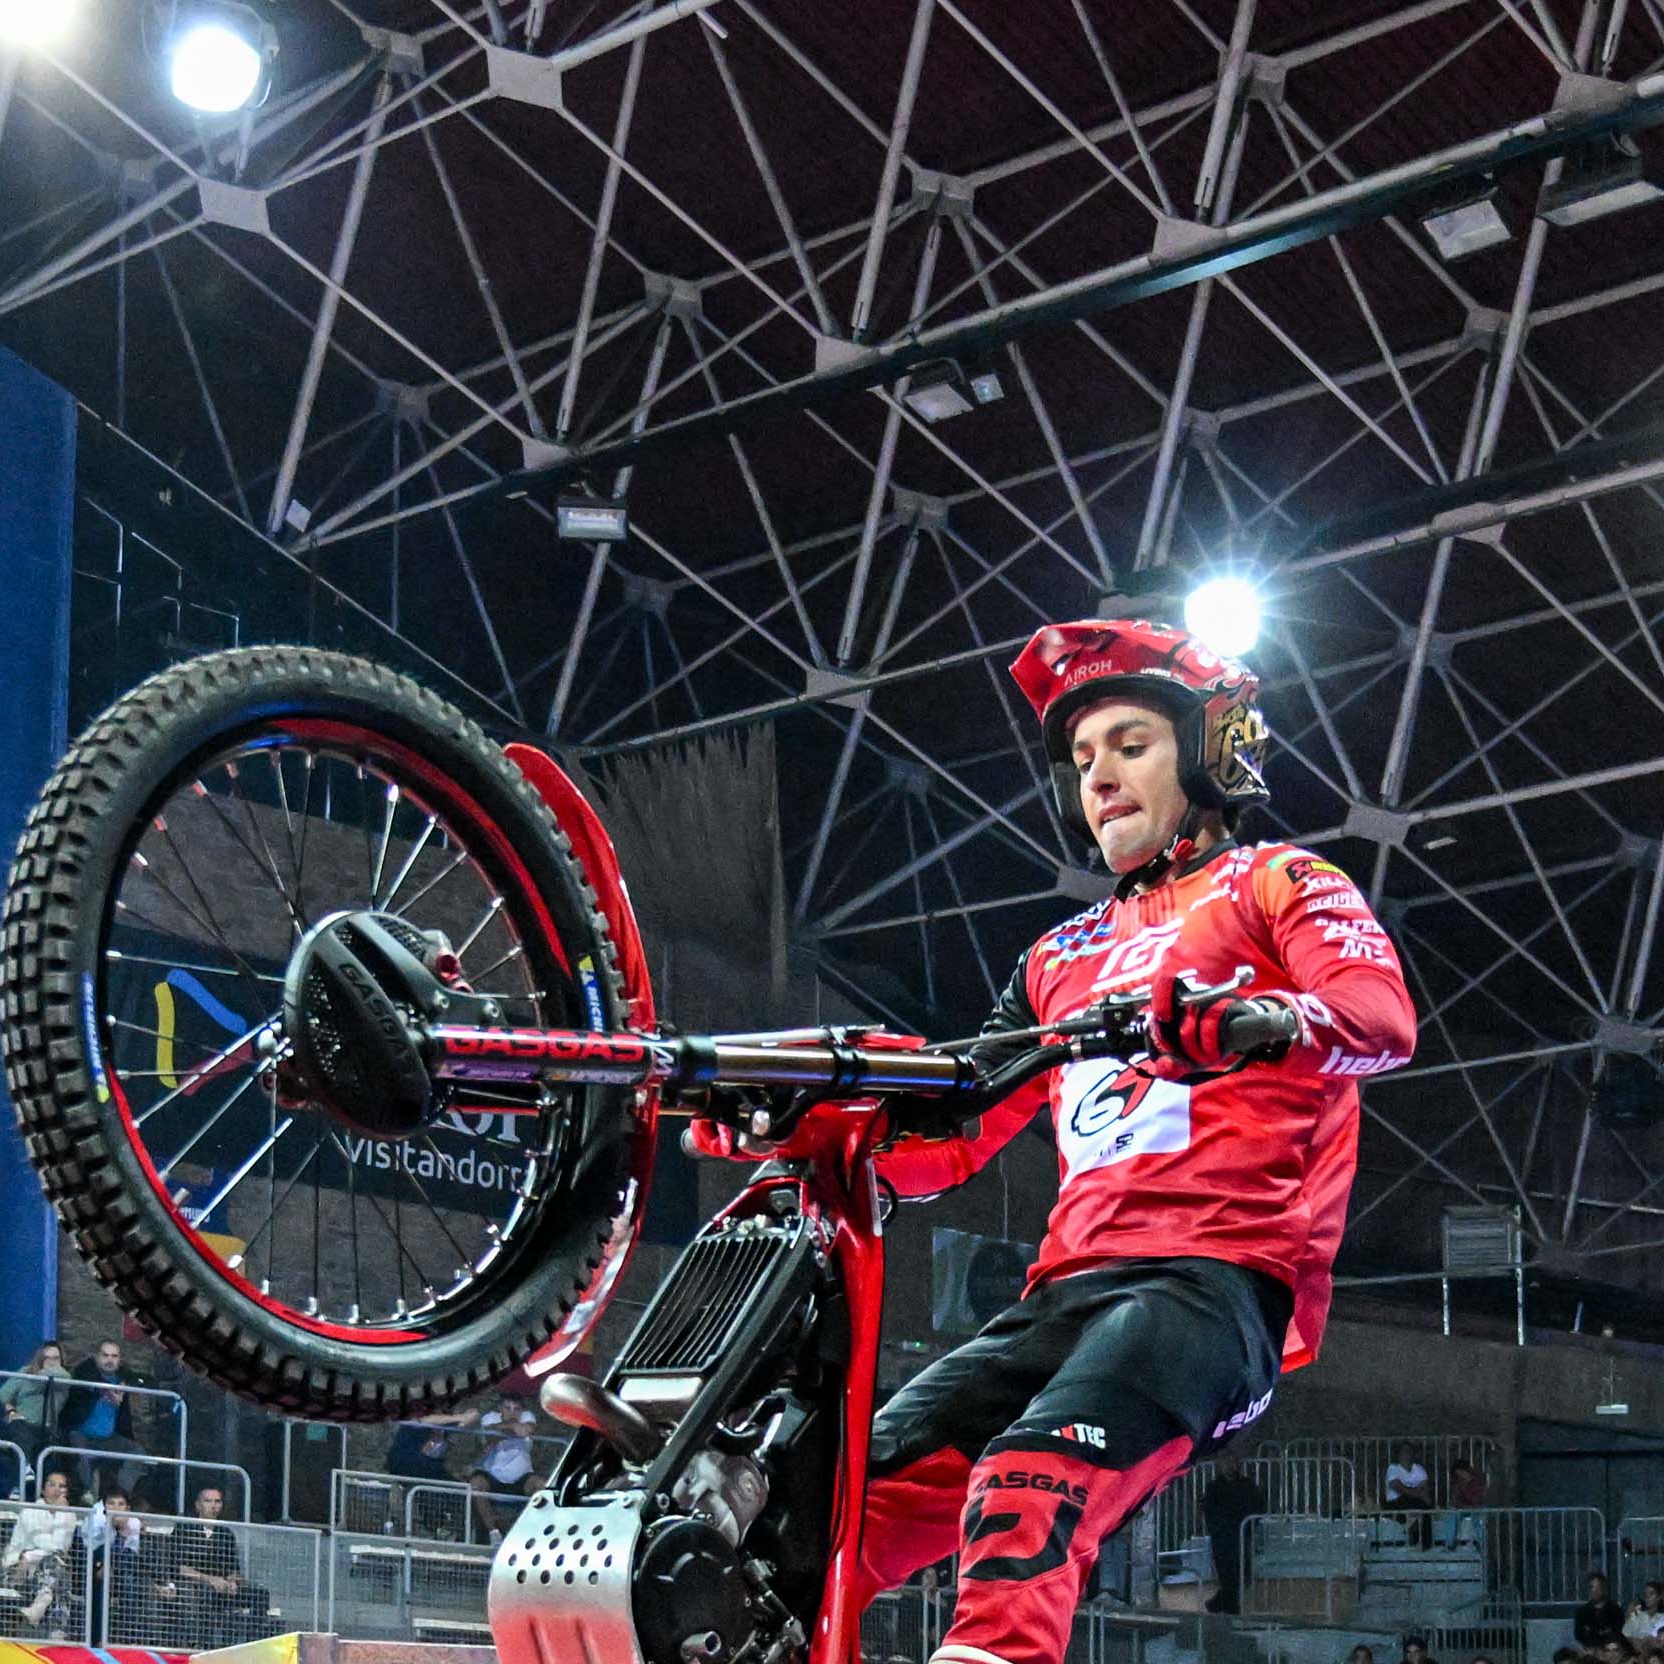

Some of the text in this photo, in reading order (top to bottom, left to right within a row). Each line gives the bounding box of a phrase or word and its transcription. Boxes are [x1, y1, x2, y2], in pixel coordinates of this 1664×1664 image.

[1064, 659, 1112, 687] AIROH
[444, 1026, 645, 1062] GASGAS
[347, 1132, 527, 1193] visitandorr
